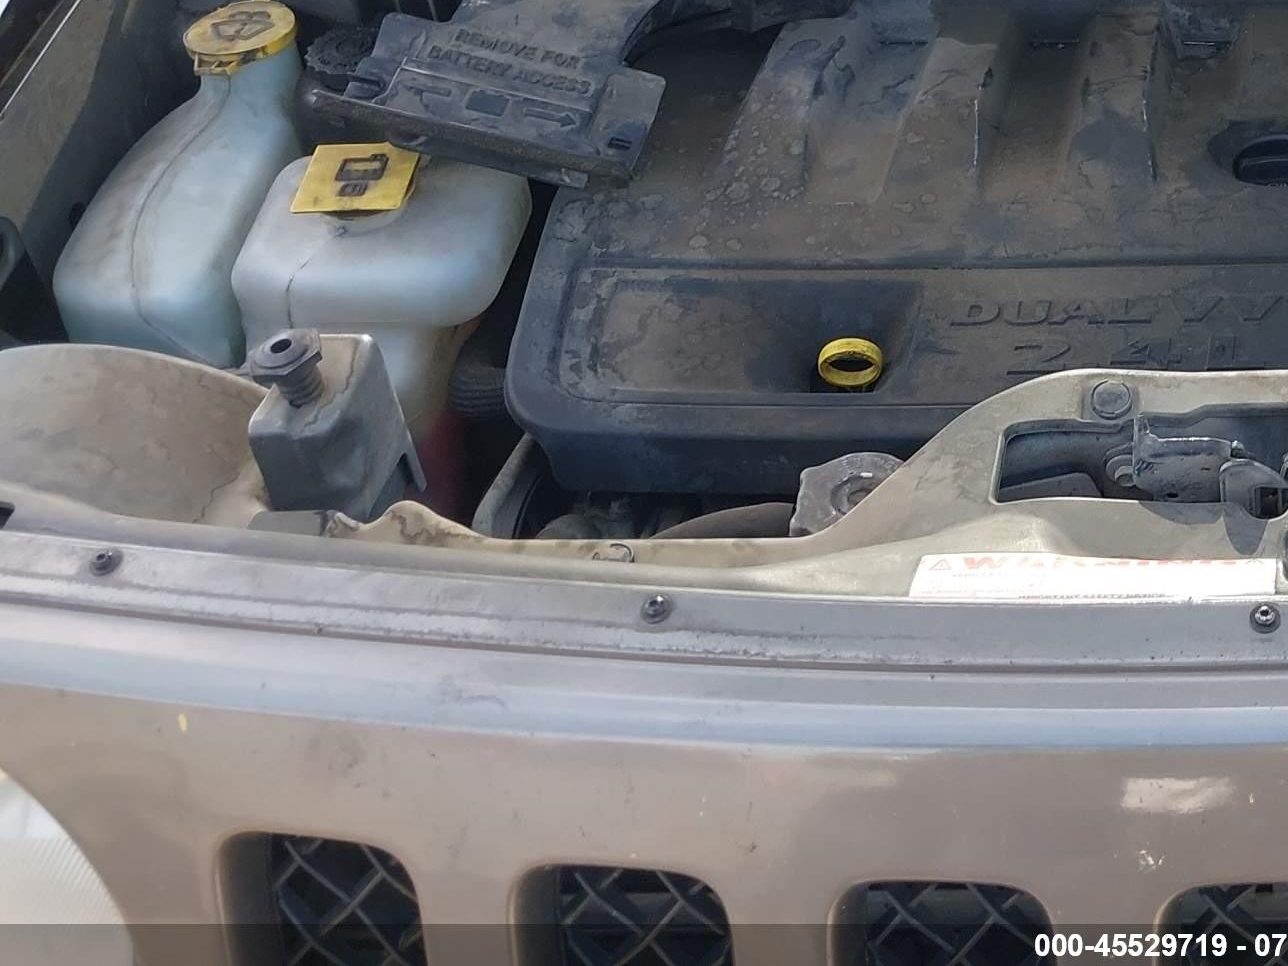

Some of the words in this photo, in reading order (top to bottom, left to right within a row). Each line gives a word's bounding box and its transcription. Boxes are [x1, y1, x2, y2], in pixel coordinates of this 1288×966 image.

[454, 28, 539, 61] REMOVE
[540, 49, 584, 70] FOR
[428, 45, 513, 78] BATTERY
[512, 70, 594, 96] ACCESS
[949, 297, 1154, 327] DUAL
